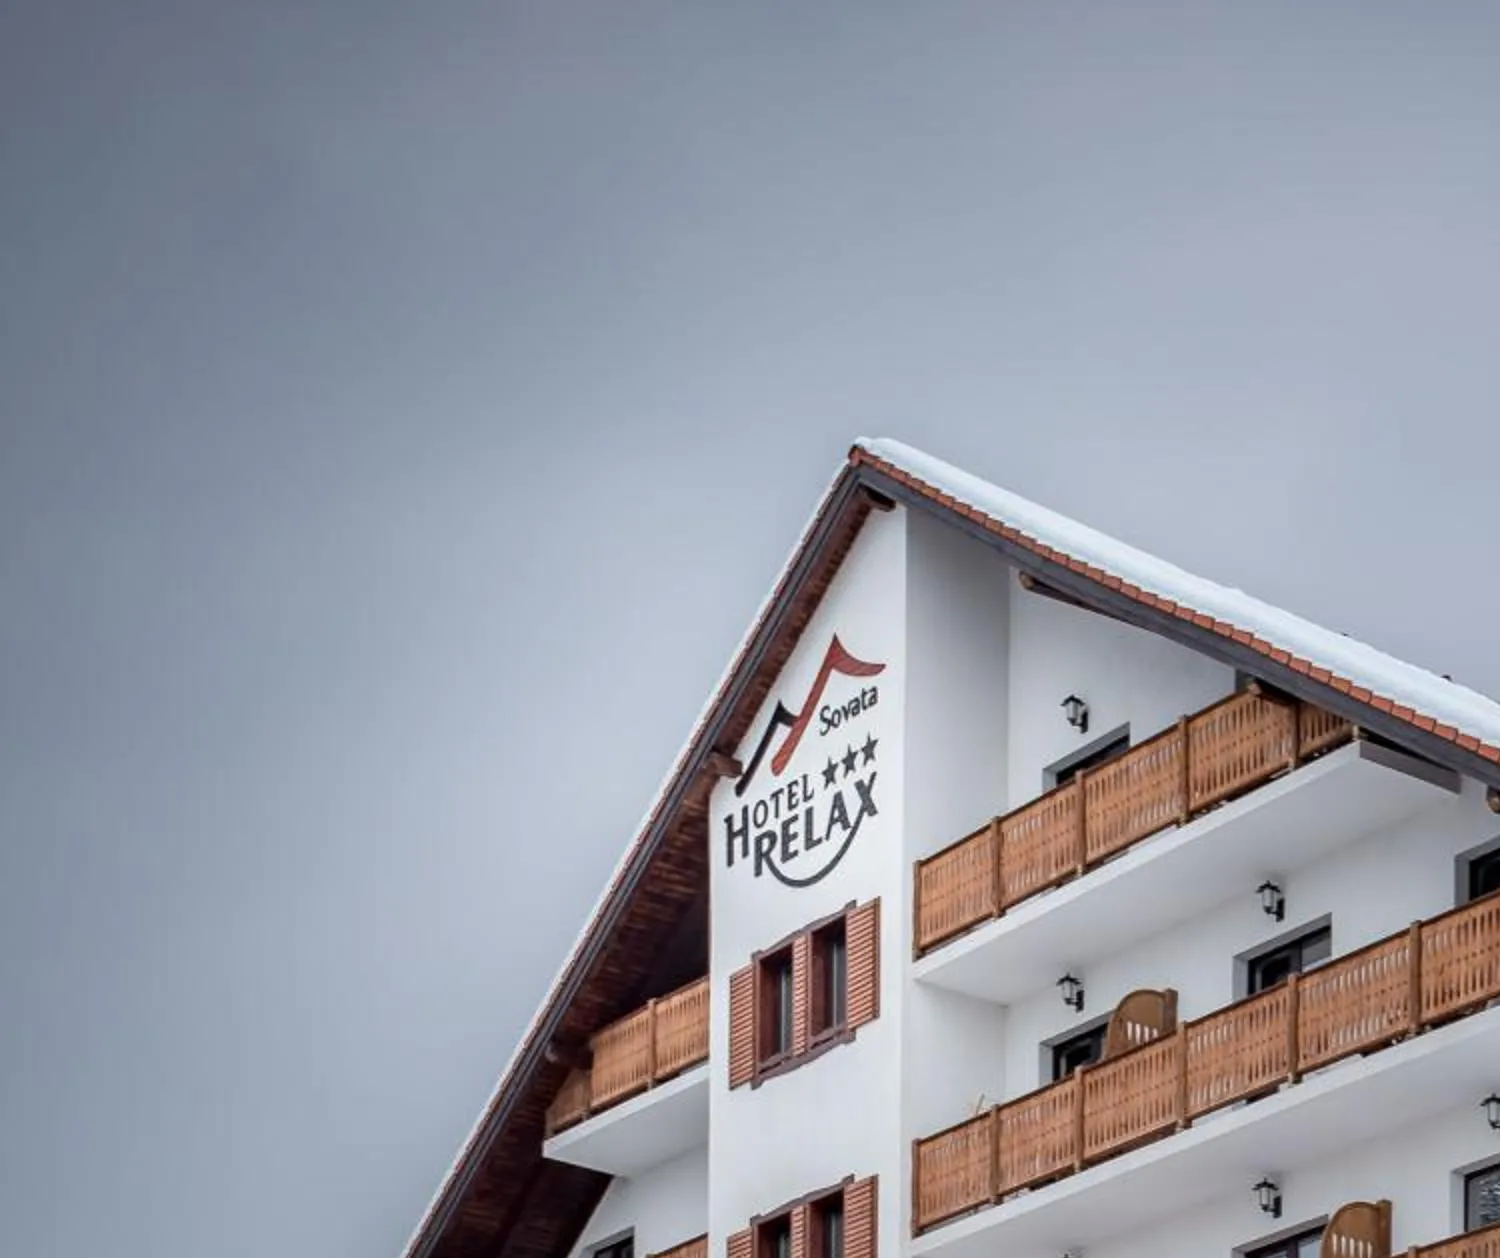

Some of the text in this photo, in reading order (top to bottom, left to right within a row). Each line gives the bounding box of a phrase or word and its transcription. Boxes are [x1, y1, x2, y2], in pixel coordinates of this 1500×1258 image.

[818, 685, 880, 737] Sovata
[723, 773, 815, 868] HOTEL
[753, 771, 879, 888] RELAX
